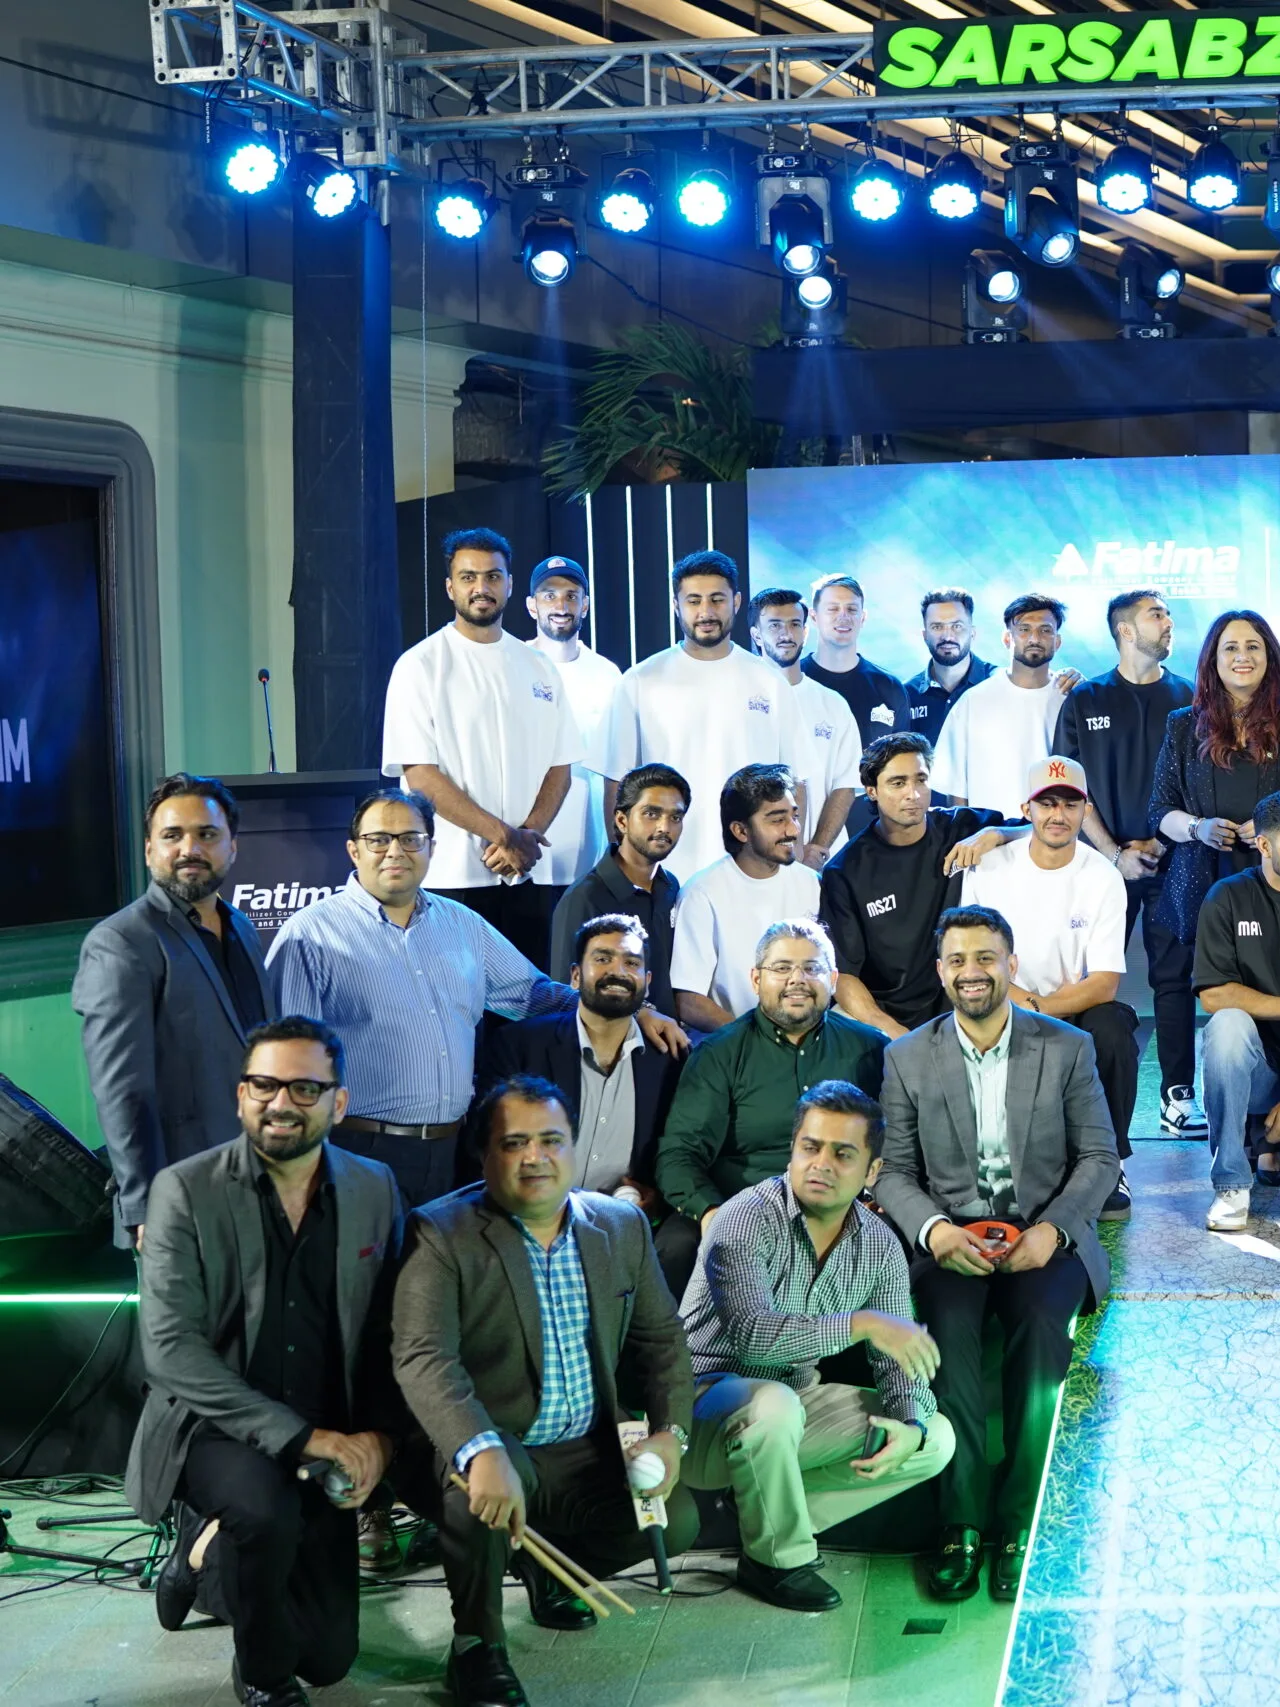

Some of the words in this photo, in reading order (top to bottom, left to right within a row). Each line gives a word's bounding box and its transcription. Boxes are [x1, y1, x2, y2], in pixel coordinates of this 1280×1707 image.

[1092, 540, 1241, 575] Fatima
[1086, 715, 1111, 731] TS26
[0, 718, 31, 783] M
[866, 894, 897, 918] MS27
